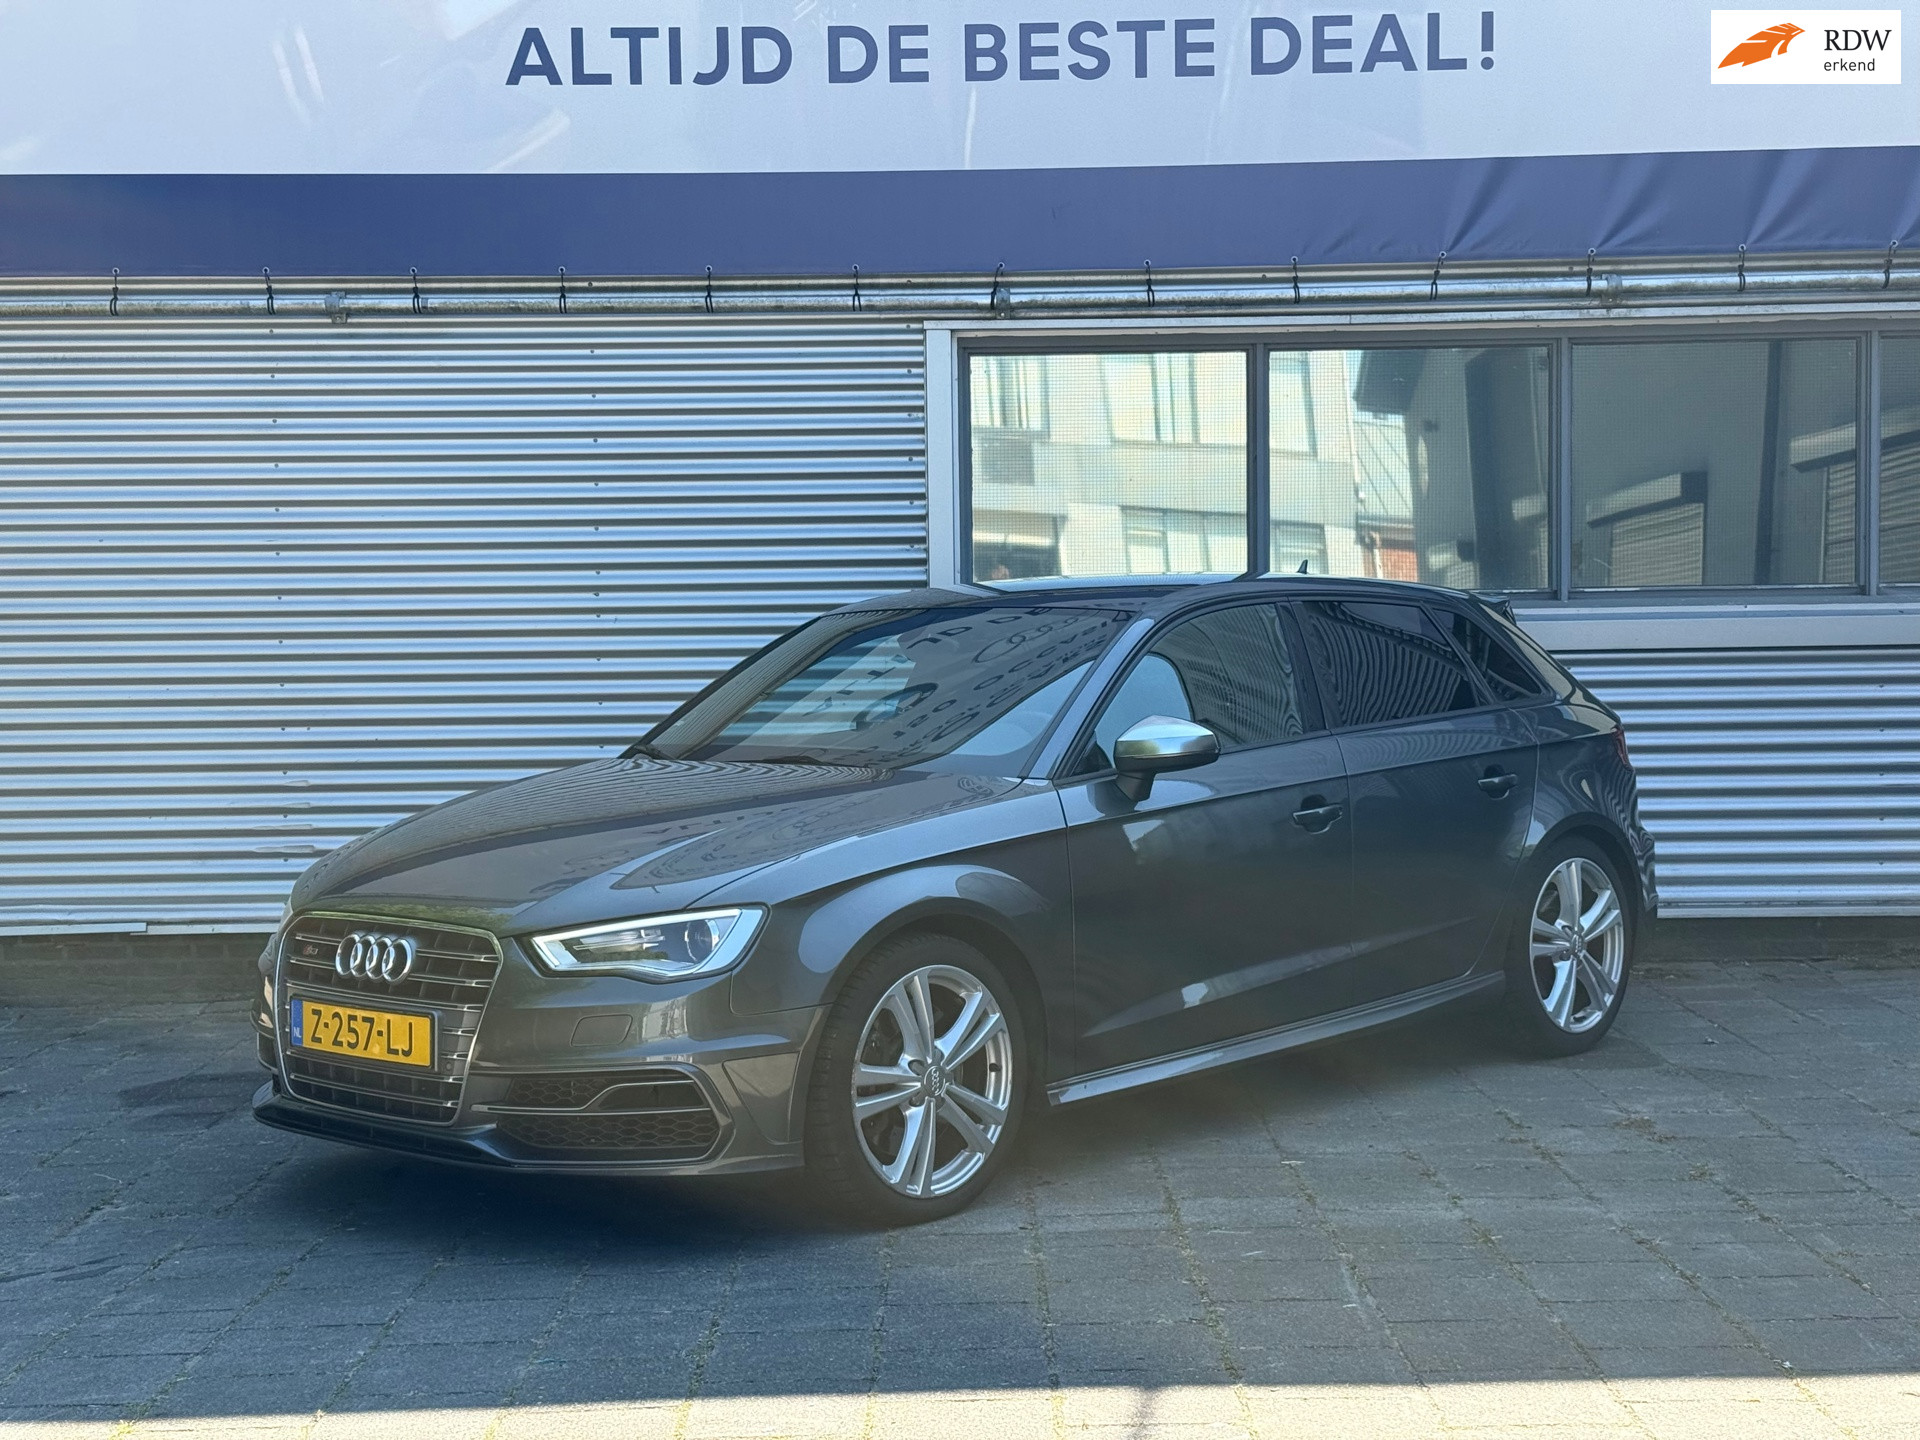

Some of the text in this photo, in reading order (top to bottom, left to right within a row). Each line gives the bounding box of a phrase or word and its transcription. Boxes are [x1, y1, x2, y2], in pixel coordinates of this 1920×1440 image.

[505, 11, 1495, 86] ALTIJD DE BESTE DEAL!
[293, 1026, 302, 1038] NL
[311, 1008, 413, 1057] Z-257-LJ
